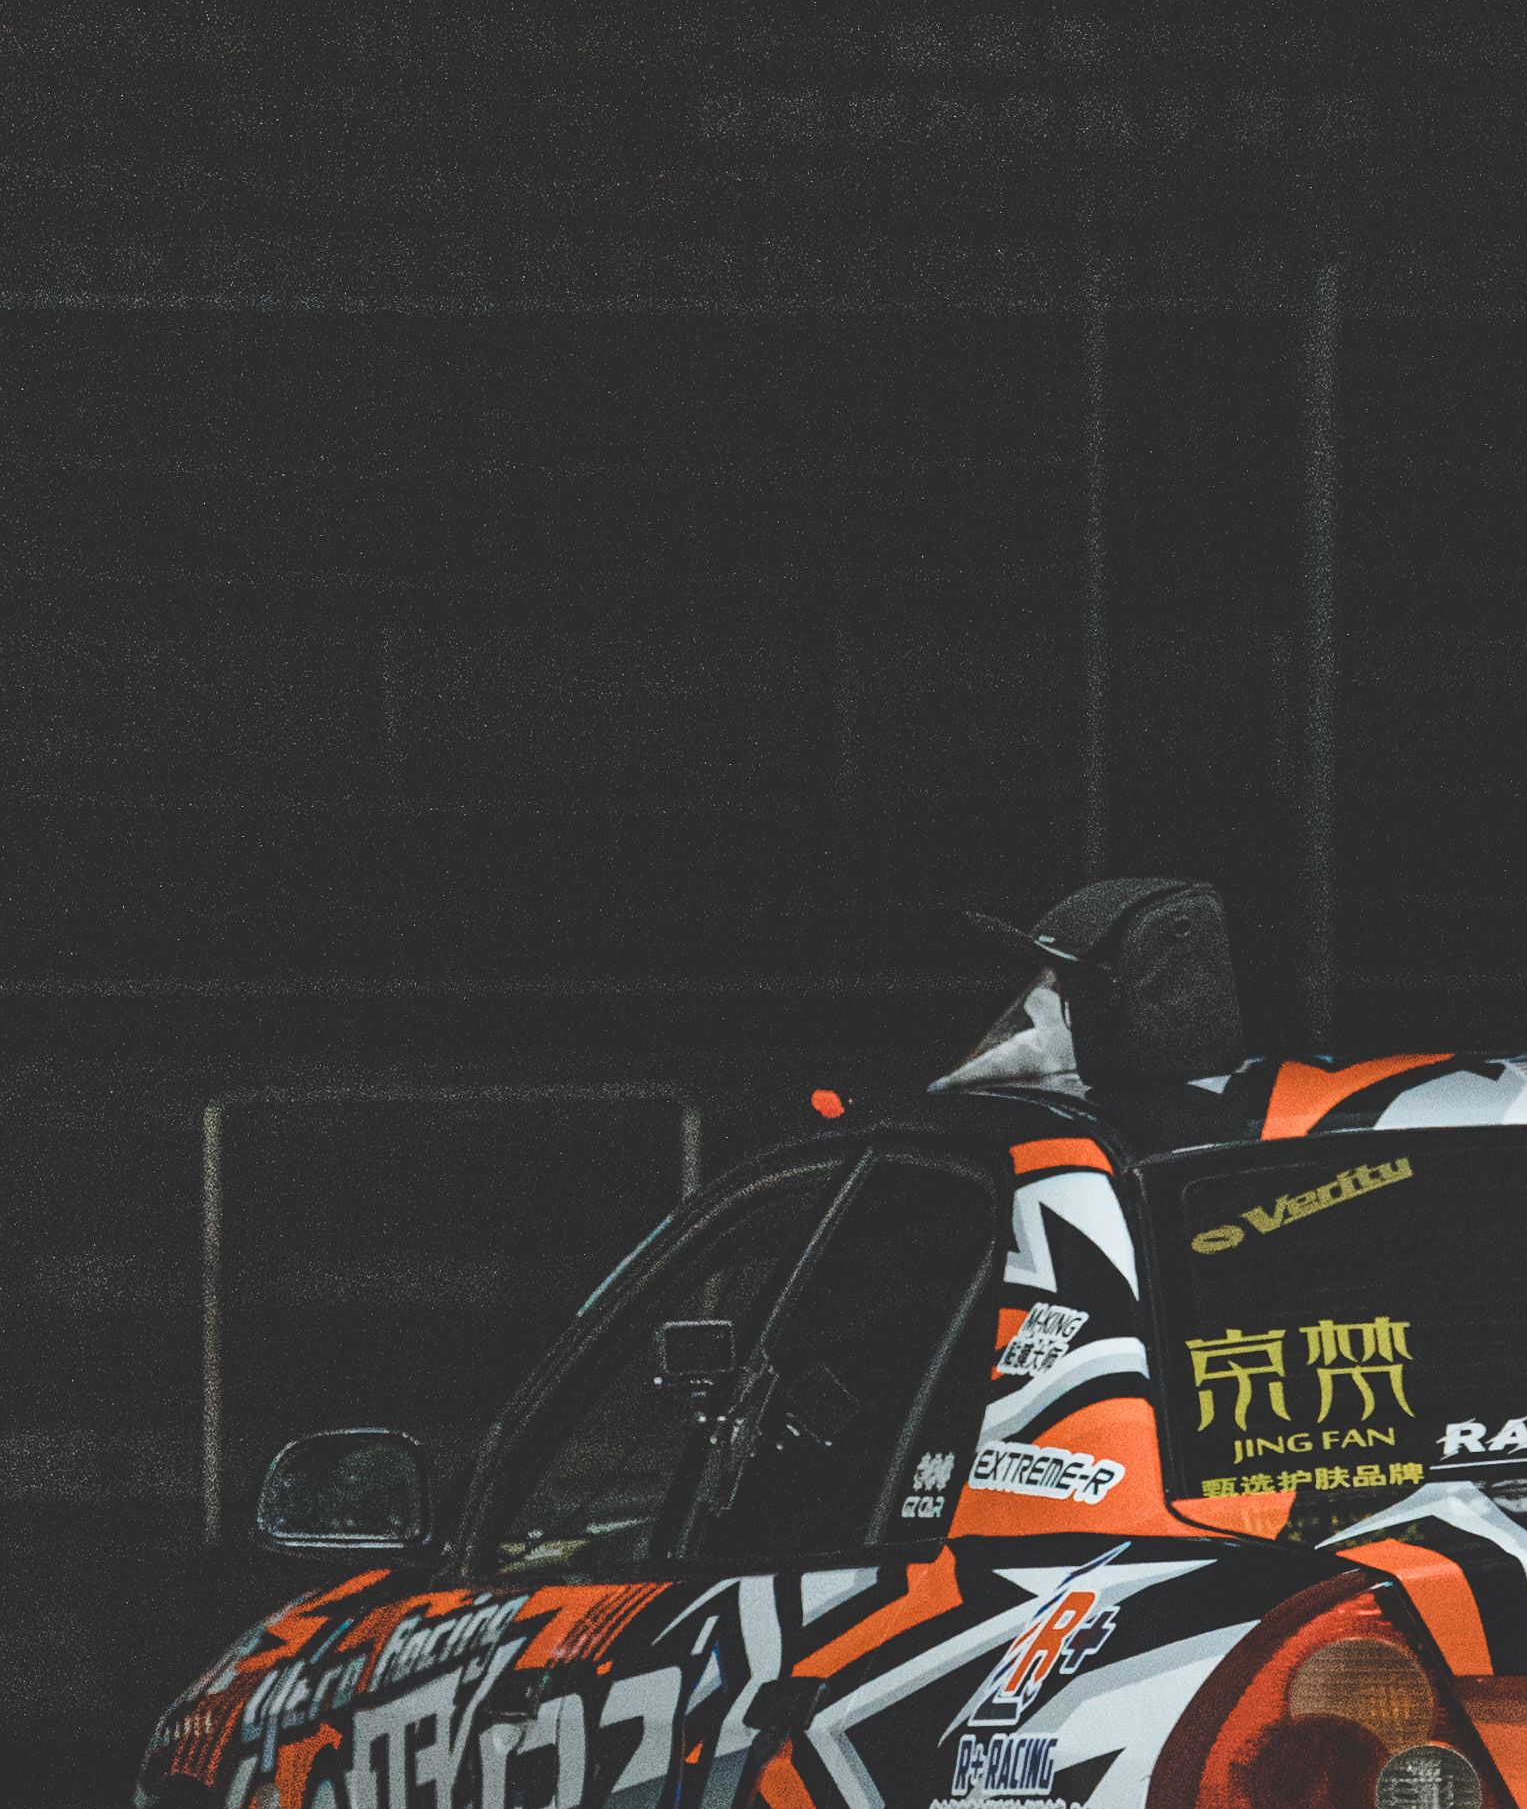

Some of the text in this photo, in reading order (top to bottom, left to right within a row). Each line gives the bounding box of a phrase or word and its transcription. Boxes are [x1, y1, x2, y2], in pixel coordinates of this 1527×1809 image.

[1233, 1427, 1396, 1465] JING FAN
[973, 1449, 1115, 1495] EXTREME-R
[1202, 1462, 1425, 1498] 甄选护肤品牌
[984, 1736, 1058, 1792] RACING
